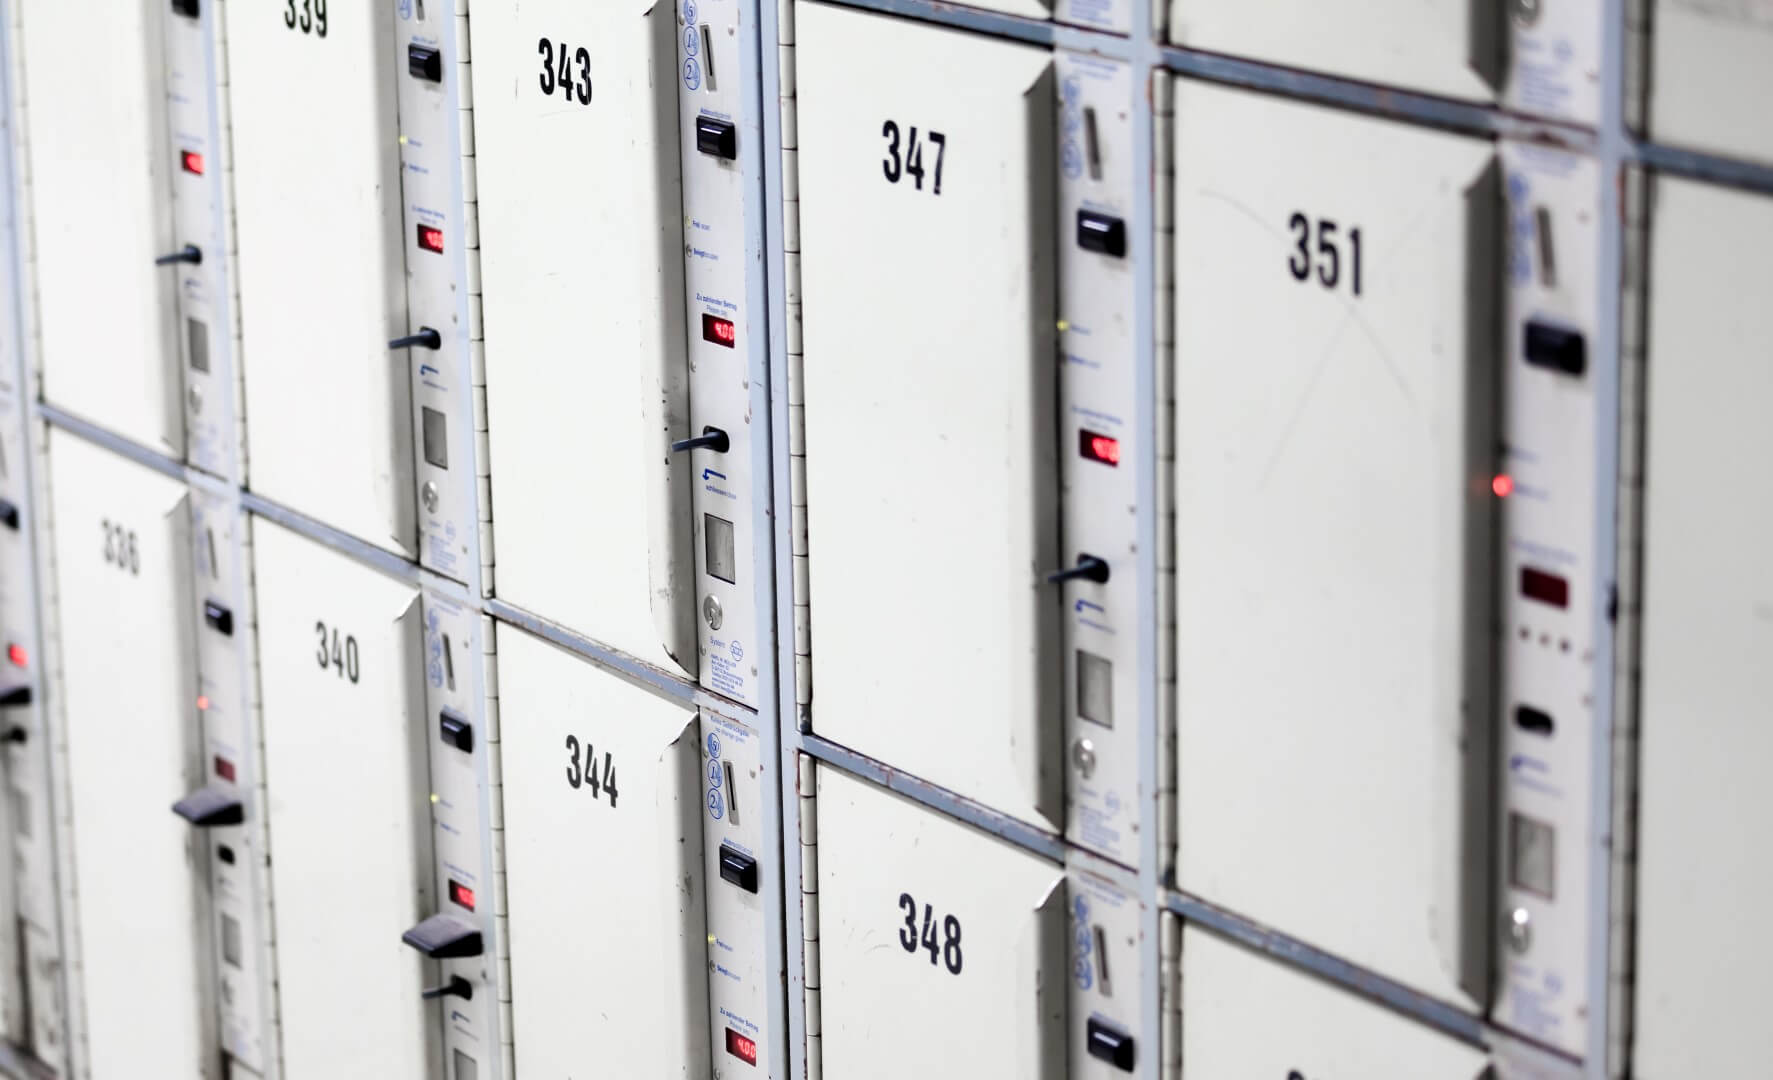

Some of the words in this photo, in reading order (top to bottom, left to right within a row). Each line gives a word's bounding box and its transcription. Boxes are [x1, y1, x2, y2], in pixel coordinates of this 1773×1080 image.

[284, 0, 329, 39] 339
[538, 37, 593, 106] 343
[882, 119, 946, 195] 347
[1289, 212, 1364, 296] 351
[316, 621, 360, 685] 340
[566, 734, 618, 809] 344
[899, 892, 963, 976] 348
